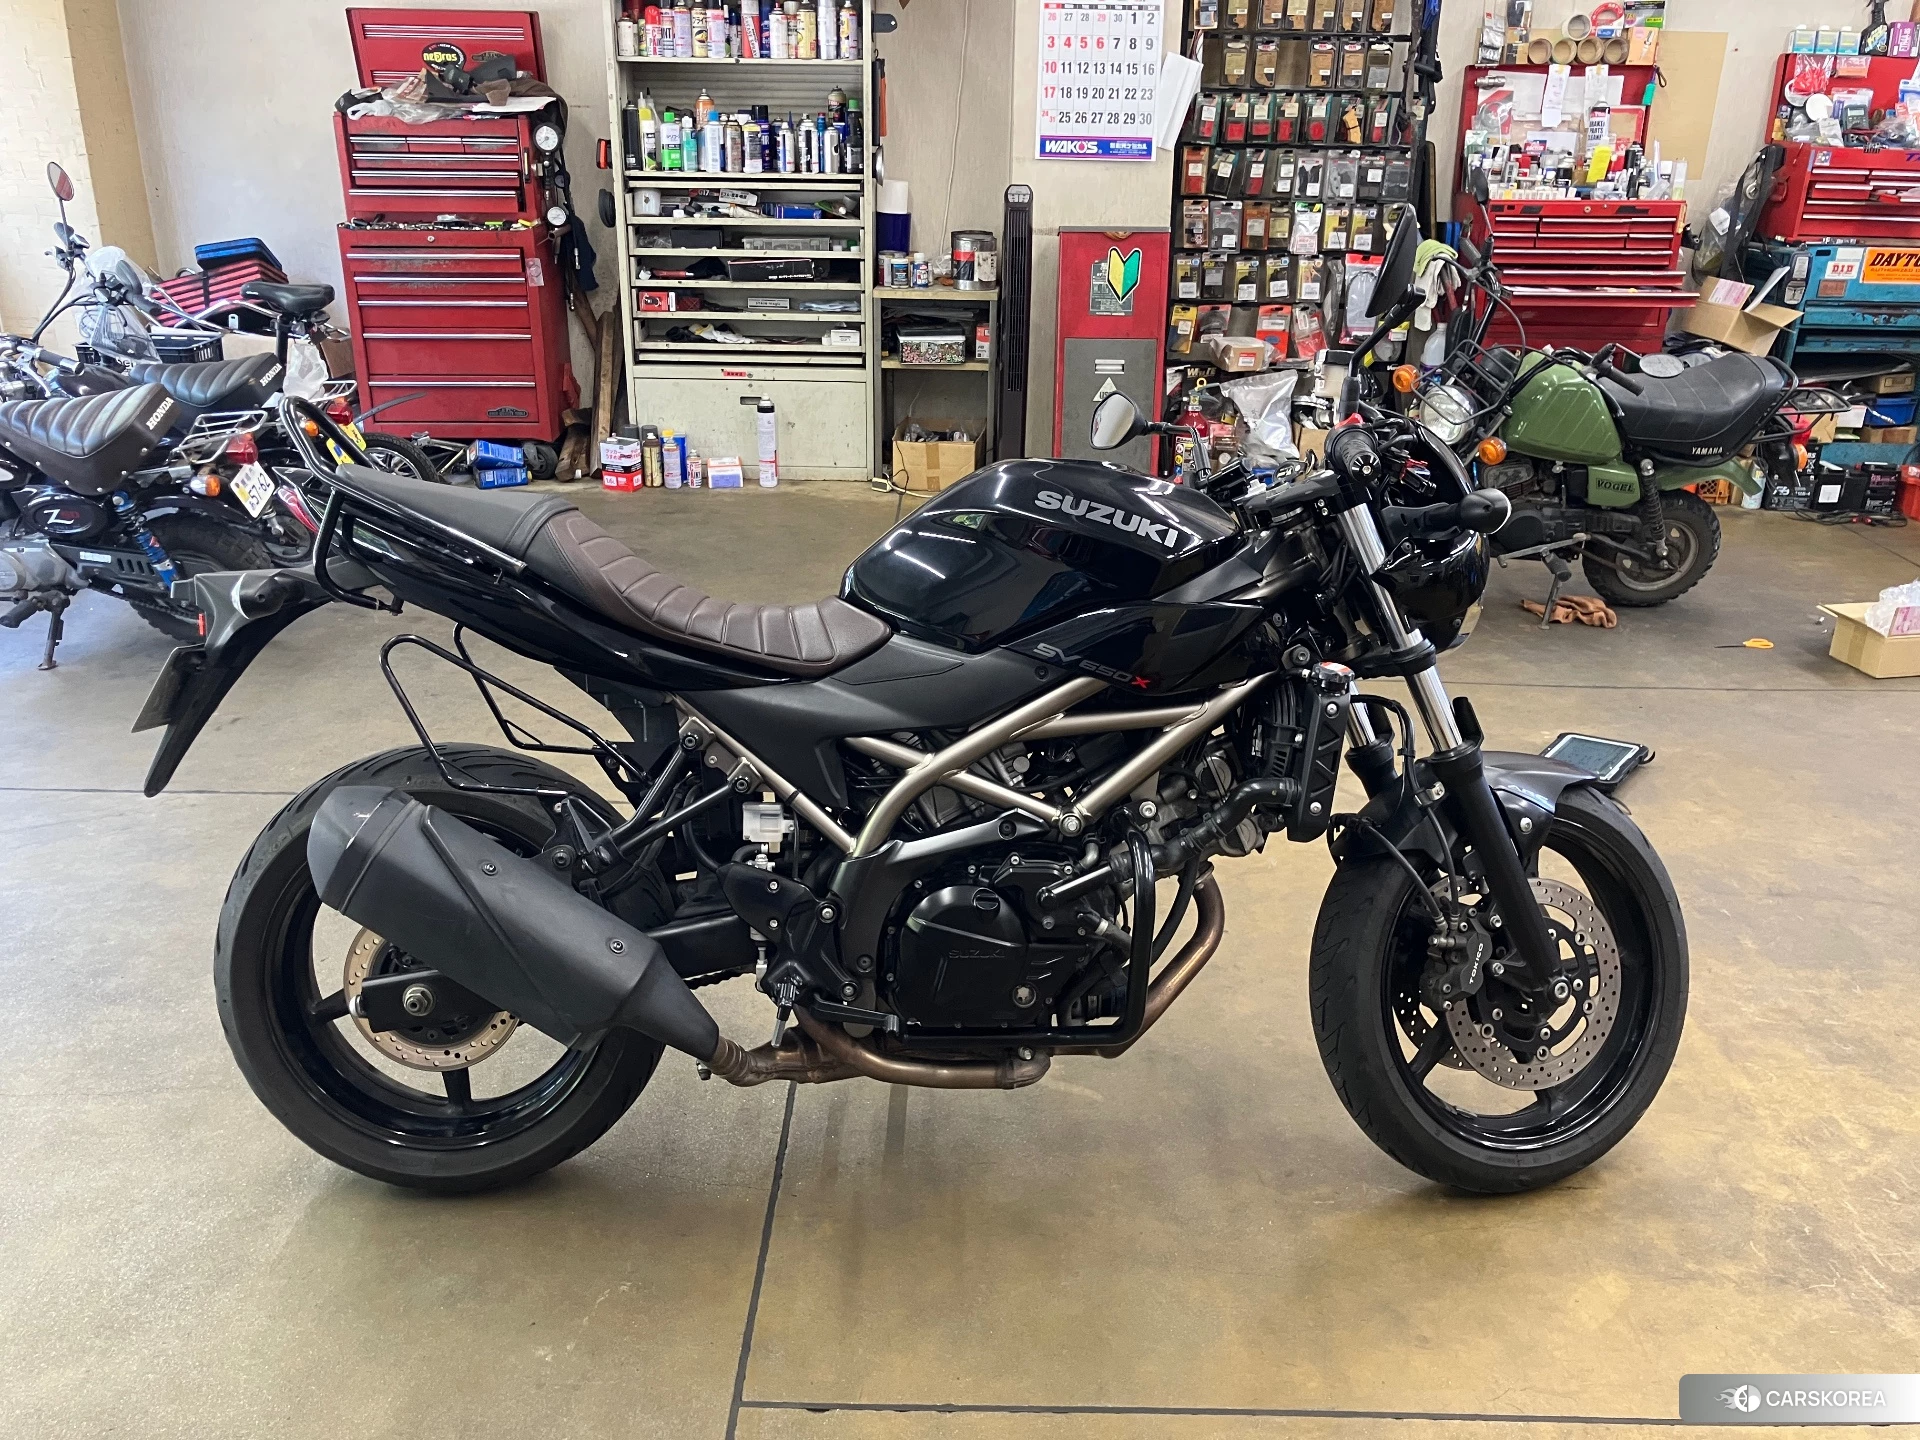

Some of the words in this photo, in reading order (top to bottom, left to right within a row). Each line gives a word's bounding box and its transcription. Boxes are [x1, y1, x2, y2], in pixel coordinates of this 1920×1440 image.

[1048, 13, 1057, 21] 26
[1064, 13, 1073, 21] 27
[1081, 13, 1089, 21] 28
[1097, 13, 1106, 22] 29
[1113, 14, 1122, 22] 30
[1131, 12, 1137, 24] 1
[1147, 13, 1155, 24] 2
[1047, 36, 1055, 48] 3
[1064, 36, 1071, 48] 4
[1080, 37, 1088, 49] 5
[1096, 37, 1104, 49] 6
[1113, 38, 1120, 49] 7
[1129, 38, 1137, 50] 8
[1146, 38, 1154, 50] 9
[1044, 62, 1057, 74] 10
[1061, 62, 1072, 74] 11
[1077, 62, 1089, 74] 12
[1094, 62, 1105, 75] 13
[1110, 63, 1122, 75] 14
[1126, 63, 1138, 75] 15
[1142, 63, 1154, 75] 16
[1044, 86, 1056, 98] 17
[1060, 87, 1072, 99] 18
[1076, 87, 1088, 99] 19
[1092, 87, 1104, 99] 20
[1108, 87, 1119, 100] 21
[1124, 88, 1137, 100] 22
[1141, 88, 1153, 100] 23
[1059, 111, 1070, 123] 25
[1075, 112, 1087, 124] 26
[1091, 112, 1103, 124] 27
[1107, 112, 1119, 124] 28
[1123, 112, 1135, 125] 29
[1139, 113, 1152, 125] 30
[259, 363, 283, 387] HONDA
[146, 397, 174, 431] HONDA
[1692, 447, 1723, 455] YAMAHA
[1597, 480, 1635, 492] VOGEL
[1034, 490, 1179, 548] SUZUKI
[1468, 942, 1484, 985] TOKICO
